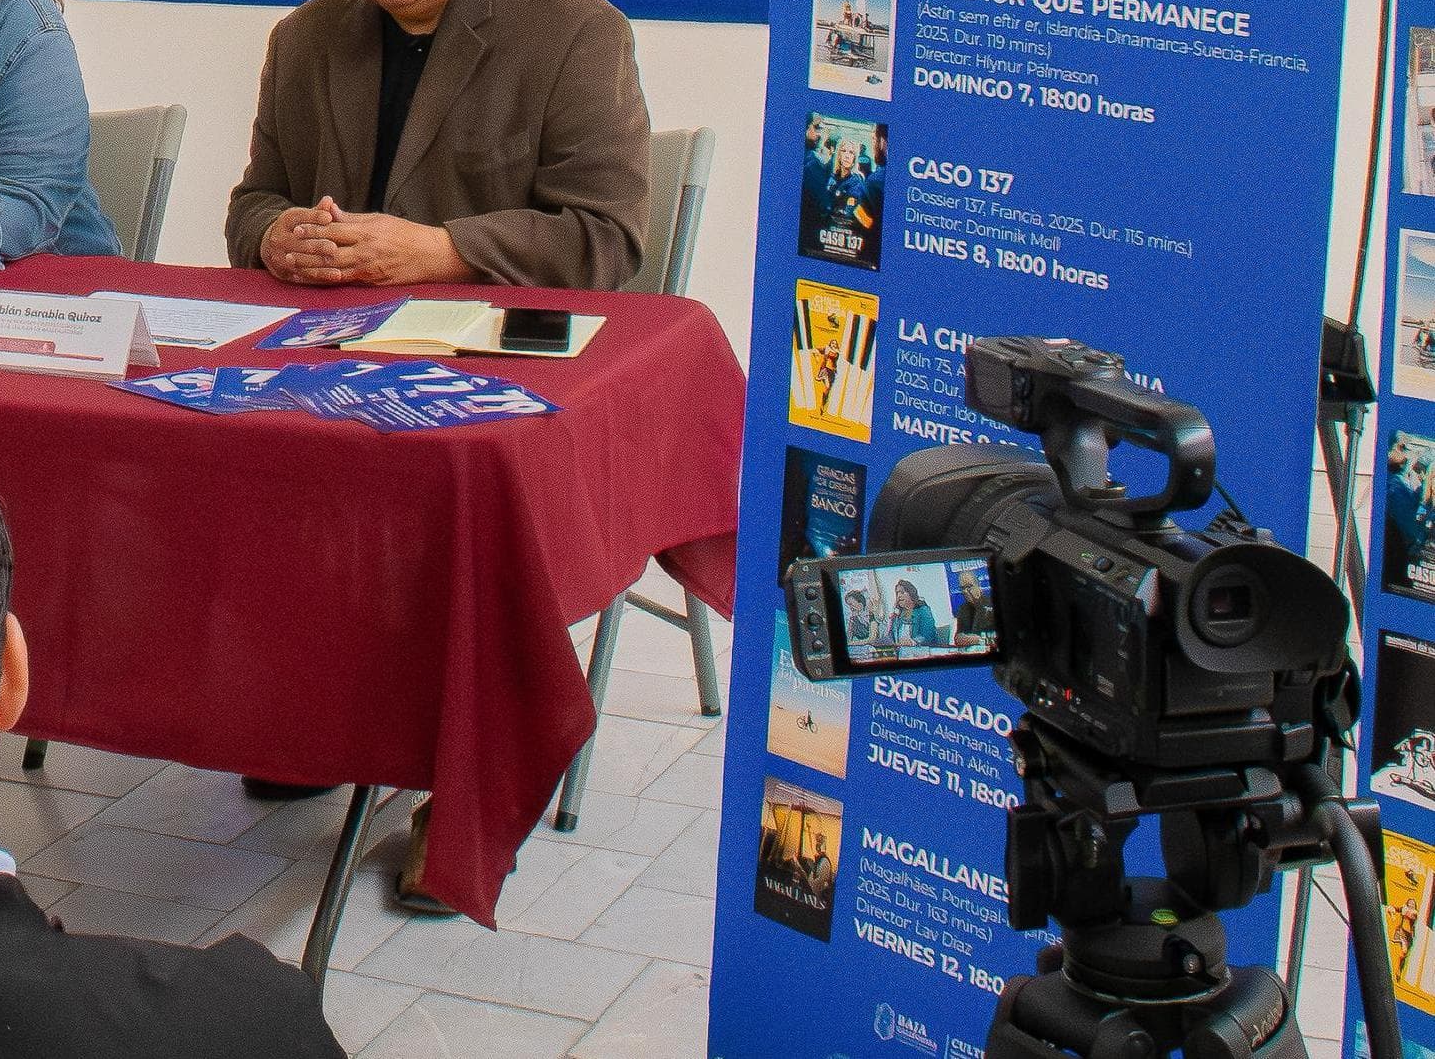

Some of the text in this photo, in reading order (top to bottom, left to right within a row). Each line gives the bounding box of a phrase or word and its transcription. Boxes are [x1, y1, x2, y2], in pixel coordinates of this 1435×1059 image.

[959, 11, 989, 26] sem
[955, 28, 983, 47] Dur.
[986, 33, 1005, 49] 119
[913, 67, 1155, 124] DOMINGO 7, 18:00 horas
[908, 156, 1014, 195] CASO 137
[906, 186, 961, 209] (Dossier
[820, 230, 846, 248] CASO
[848, 235, 864, 252] 137
[966, 219, 1026, 245] Dominik
[904, 229, 1109, 291] LUNES 8, 18:00 horas
[24, 307, 65, 320] Sarabia
[898, 318, 927, 346] LA
[896, 348, 931, 369] (Köln
[955, 404, 976, 424] Ido
[893, 411, 973, 445] MARTES
[873, 676, 1013, 738] EXPULSADO
[930, 743, 964, 767] Fatih
[867, 743, 1019, 810] JUEVES 11, 18:00
[853, 916, 964, 982] VIERNES 12,
